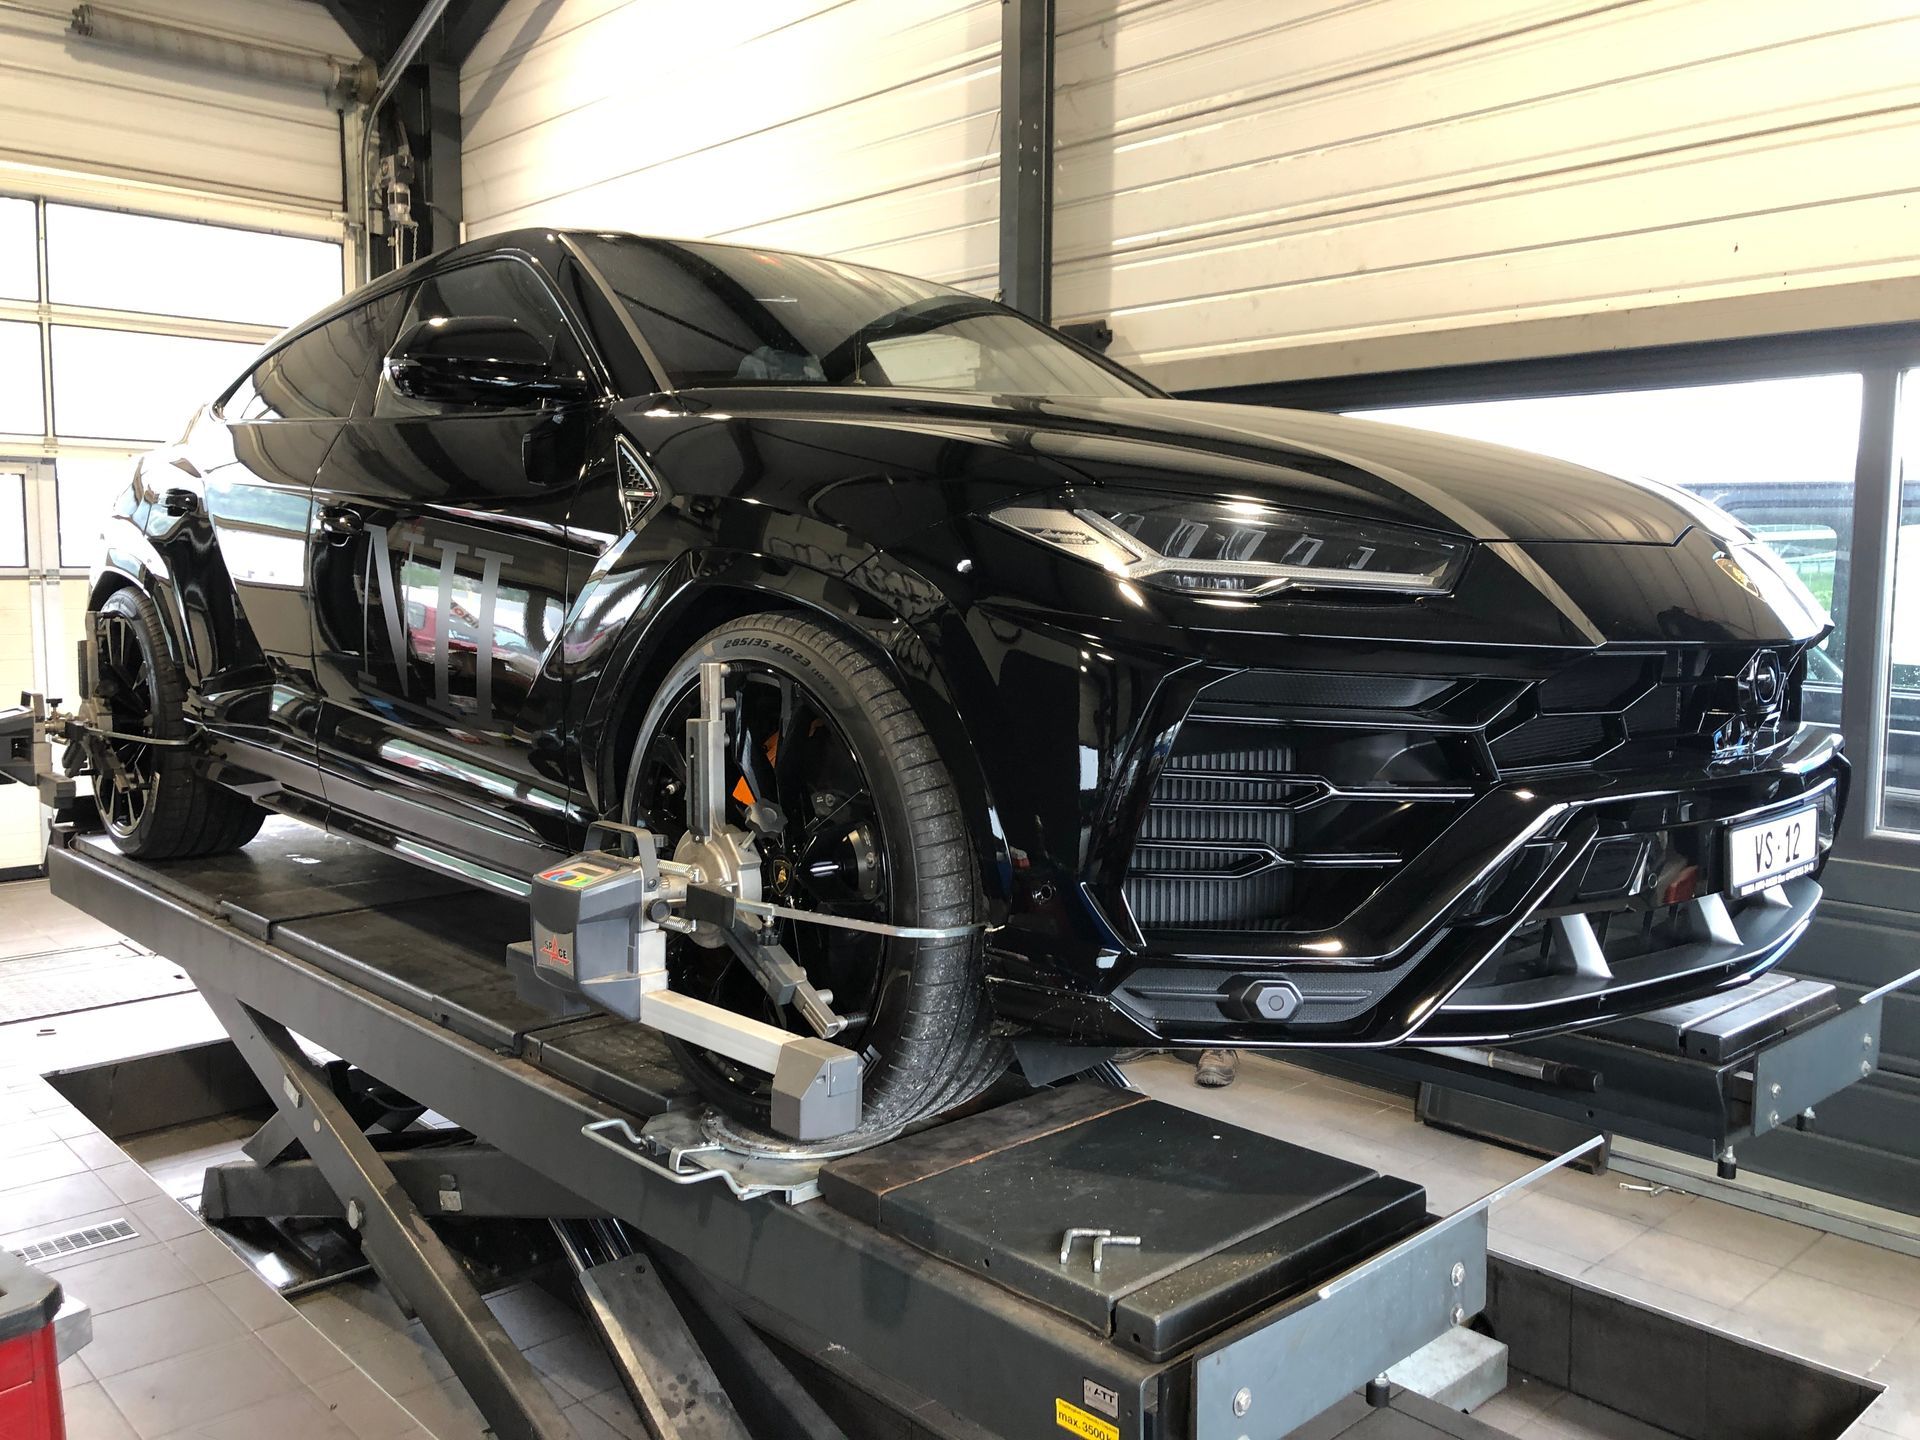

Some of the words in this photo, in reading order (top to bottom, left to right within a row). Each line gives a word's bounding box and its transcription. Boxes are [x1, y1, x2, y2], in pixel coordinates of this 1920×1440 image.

[723, 637, 772, 650] 285/35
[544, 935, 567, 961] SPACE
[1058, 1411, 1081, 1429] max.
[1082, 1421, 1105, 1440] 3500
